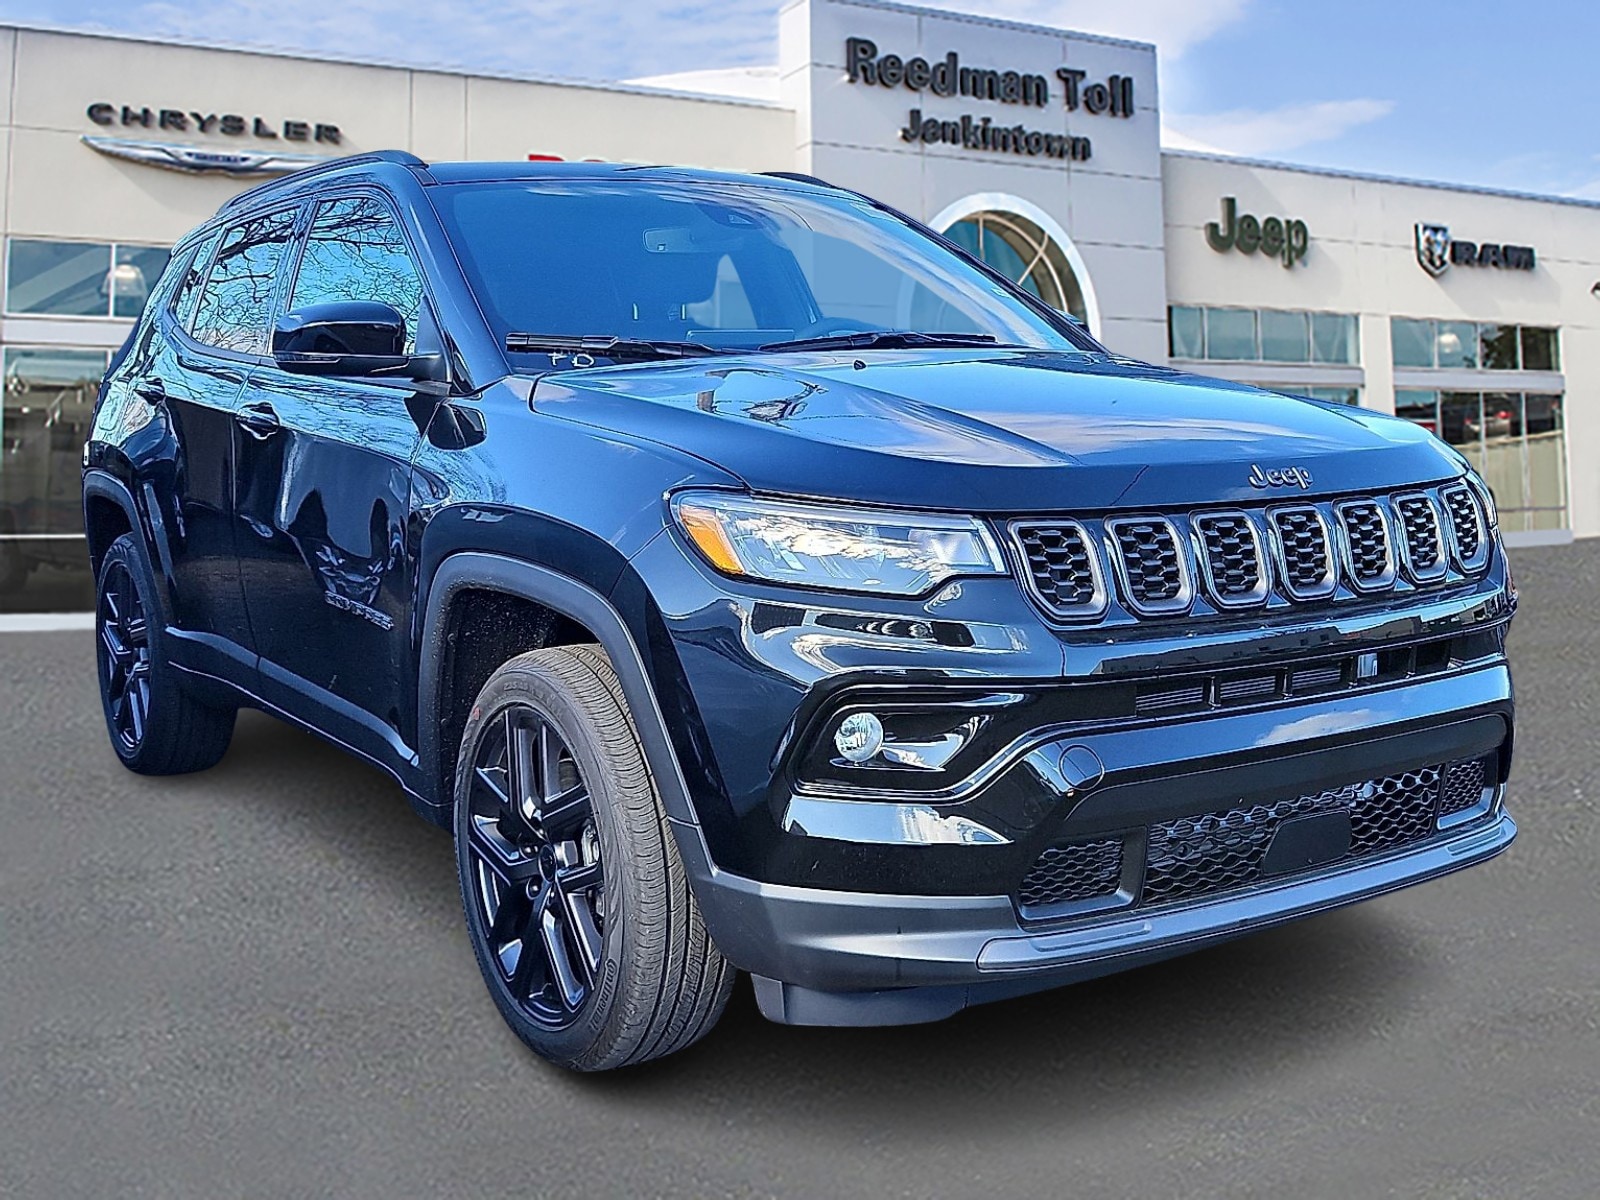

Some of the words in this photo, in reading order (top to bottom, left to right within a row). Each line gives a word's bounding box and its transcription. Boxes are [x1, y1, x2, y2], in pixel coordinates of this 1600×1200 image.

[846, 37, 1048, 108] Reedman
[1056, 67, 1134, 118] Toll
[87, 102, 341, 145] CHRYSLER
[901, 108, 1092, 161] Jenkintown
[1204, 196, 1308, 270] Jeep
[1451, 240, 1536, 270] RAM
[1248, 463, 1314, 490] Jeep
